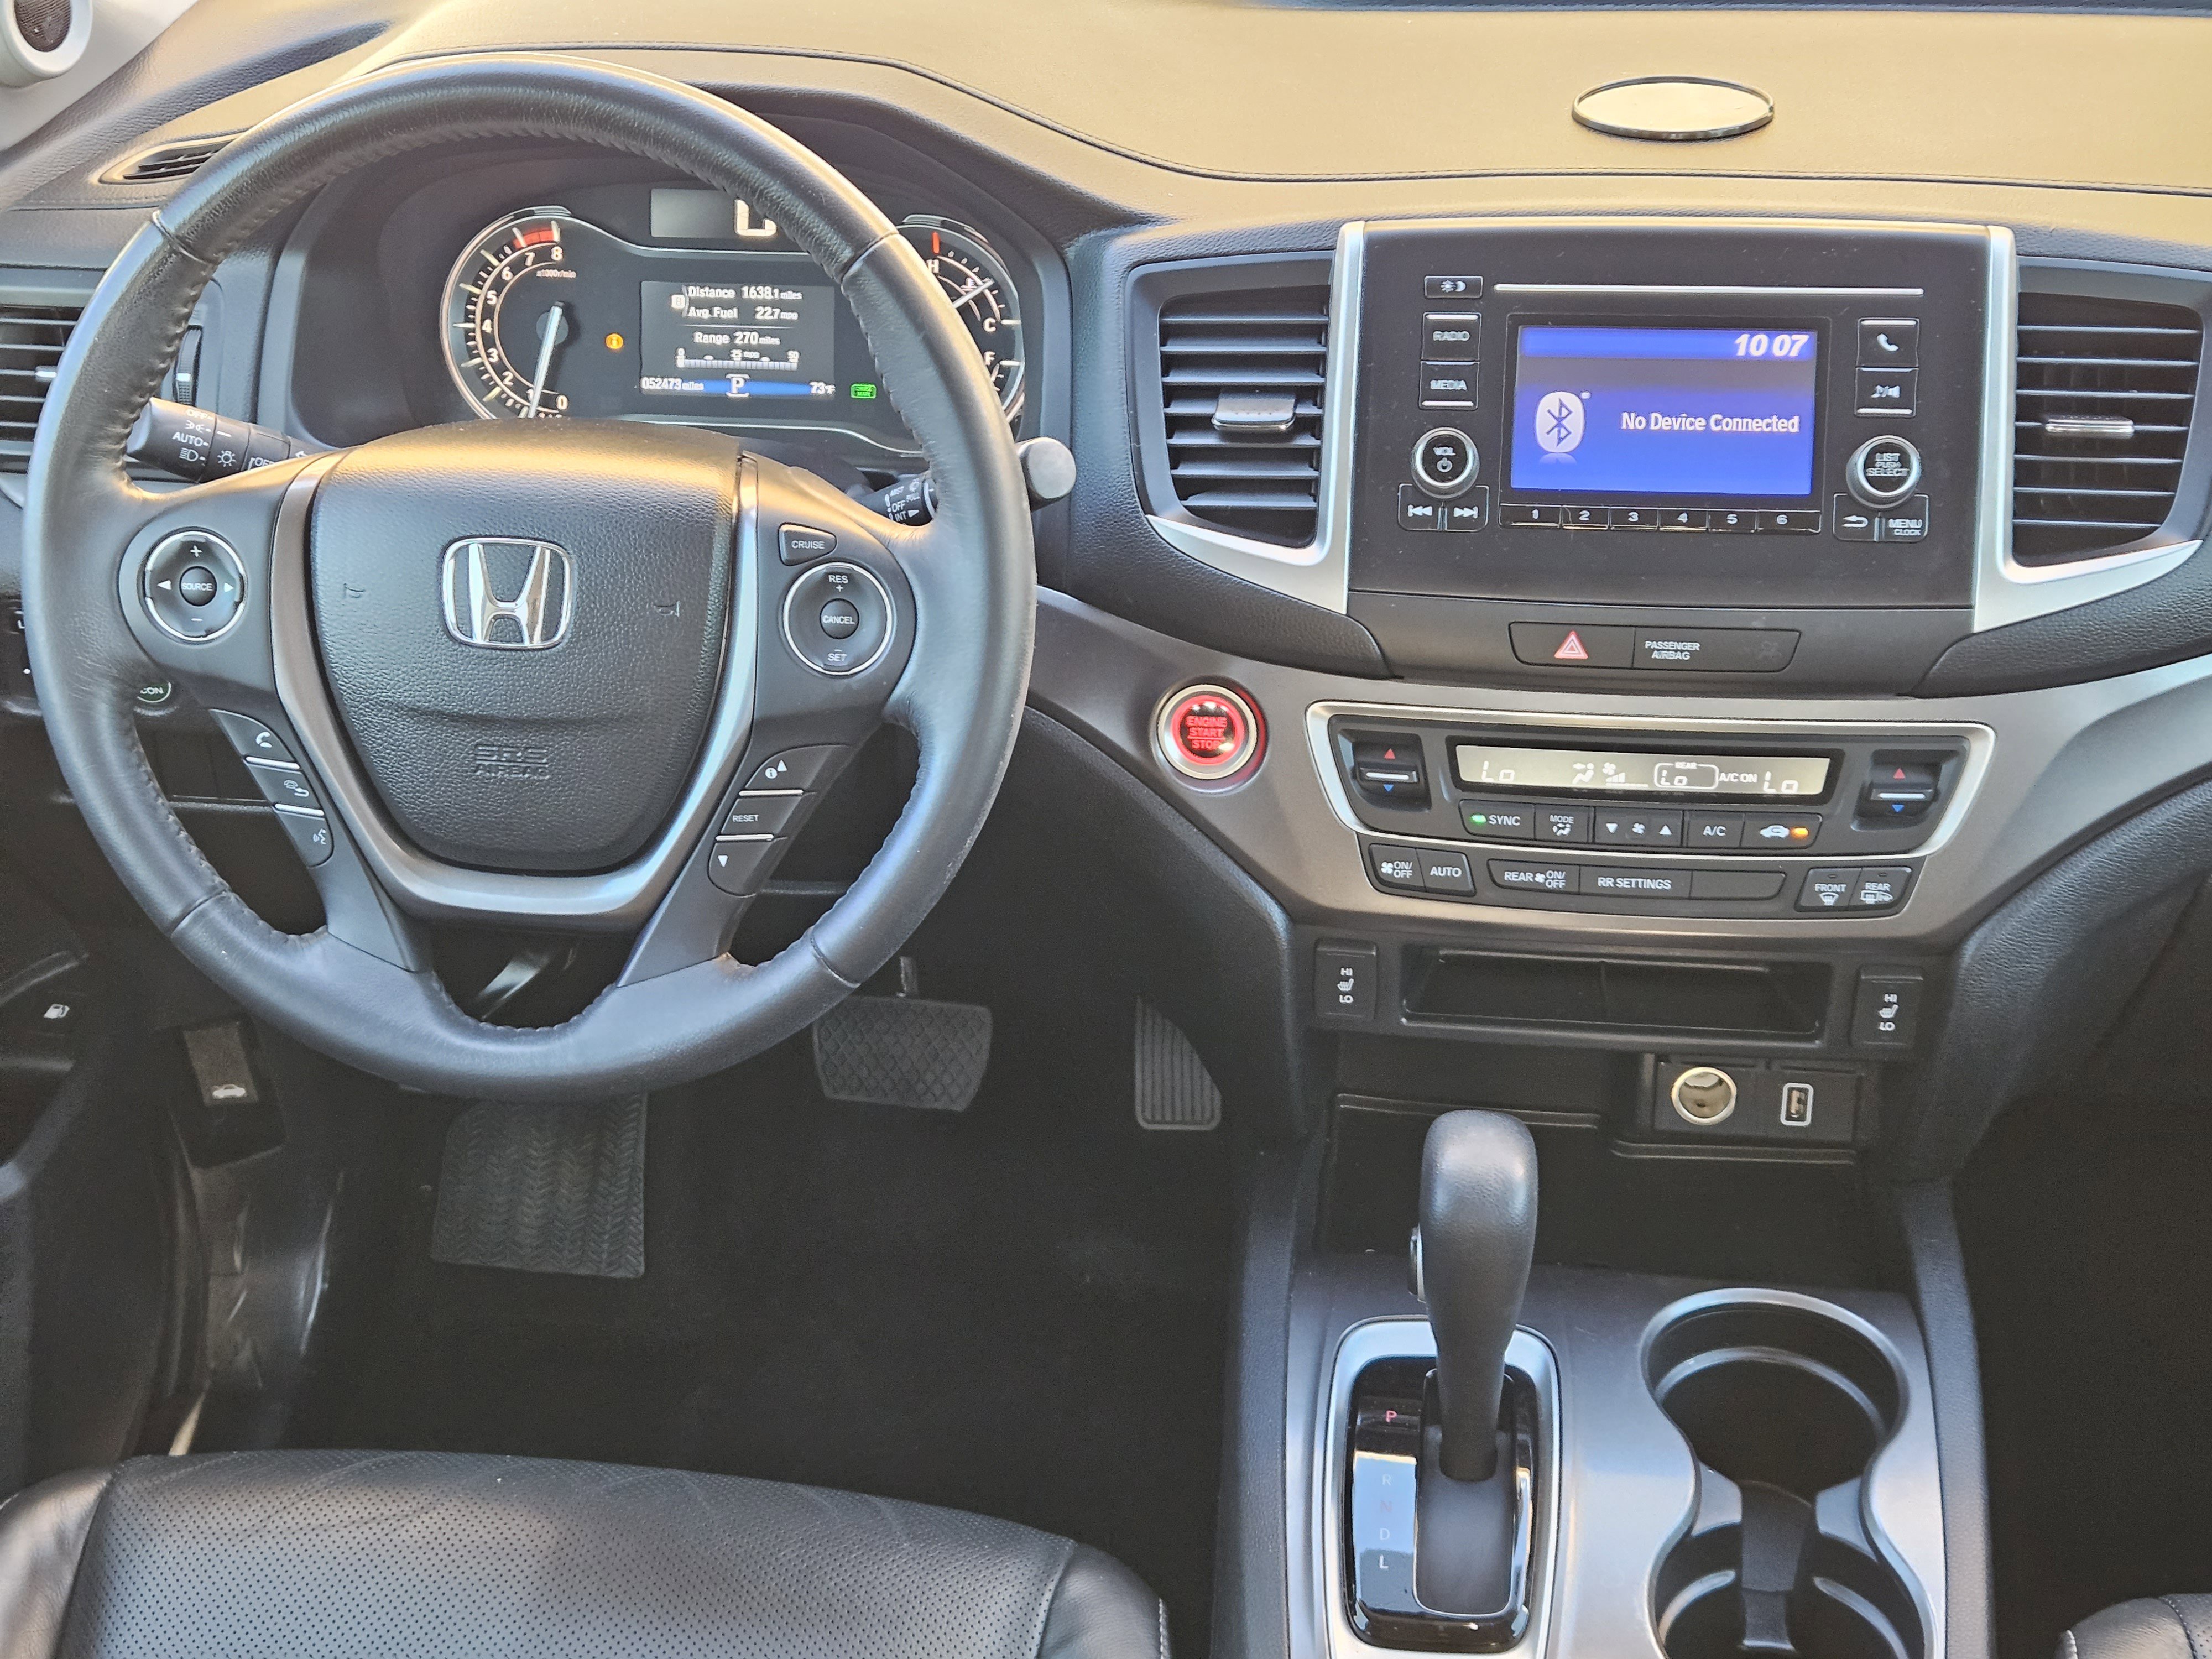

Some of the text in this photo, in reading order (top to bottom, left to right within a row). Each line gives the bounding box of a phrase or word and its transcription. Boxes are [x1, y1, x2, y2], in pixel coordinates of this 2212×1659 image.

[525, 252, 536, 266] 7
[551, 246, 563, 261] 8
[926, 259, 940, 273] H
[501, 266, 514, 280] 6
[486, 290, 498, 305] 5
[688, 286, 802, 300] Distance 1638.1 miles
[713, 307, 738, 319] Fuel
[482, 319, 493, 333] 4
[983, 317, 996, 332] C
[693, 332, 781, 345] Range 270 miles
[1433, 331, 1470, 341] RADIO
[487, 348, 498, 362] 3
[984, 351, 996, 366] F
[502, 371, 514, 386] 2
[641, 377, 682, 390] 052473
[682, 382, 704, 390] miles
[731, 377, 745, 394] P
[1430, 379, 1468, 390] MEDIA
[556, 395, 568, 410] 0
[1620, 412, 1800, 433] No Device Connected
[172, 431, 204, 447] AUTO
[1875, 453, 1901, 461] LIST
[1866, 468, 1910, 477] SELECT
[891, 500, 906, 512] OFF
[894, 510, 907, 521] INT
[1531, 509, 1539, 519] 1
[1579, 510, 1591, 521] 2
[1627, 510, 1640, 522] 3
[1676, 512, 1689, 523] 4
[1726, 514, 1738, 525] 5
[1776, 514, 1788, 525] 6
[1888, 519, 1923, 528] MENU
[791, 539, 825, 550] CRUISE
[828, 574, 849, 585] RES
[181, 582, 213, 592] SOURCE
[822, 614, 855, 625] CANCEL
[1645, 641, 1700, 651] PASSENGER
[827, 652, 847, 662] SET
[1651, 650, 1691, 660] AIRBAG
[1186, 716, 1227, 727] ENGINE
[1189, 727, 1224, 737] START
[1192, 740, 1221, 750] STOP
[1719, 773, 1758, 783] A/C ON
[732, 814, 759, 823] RESET
[1489, 814, 1521, 826] SYNC
[1550, 815, 1574, 824] MODE
[1702, 826, 1726, 837] A/C
[1393, 860, 1412, 871] ON/
[1430, 865, 1462, 877] AUTO
[1393, 869, 1413, 879] OFF
[1504, 871, 1534, 882] REAR
[1546, 870, 1566, 880] ON/
[1545, 878, 1566, 888] OFF
[1598, 877, 1672, 891] RR SETTINGS
[1814, 883, 1847, 893] FRONT
[1865, 882, 1891, 891] REAR
[1340, 968, 1353, 976] HI
[1386, 1410, 1398, 1422] P
[1383, 1474, 1392, 1486] R
[1380, 1500, 1392, 1512] N
[1380, 1529, 1391, 1541] D
[1379, 1555, 1389, 1569] L
